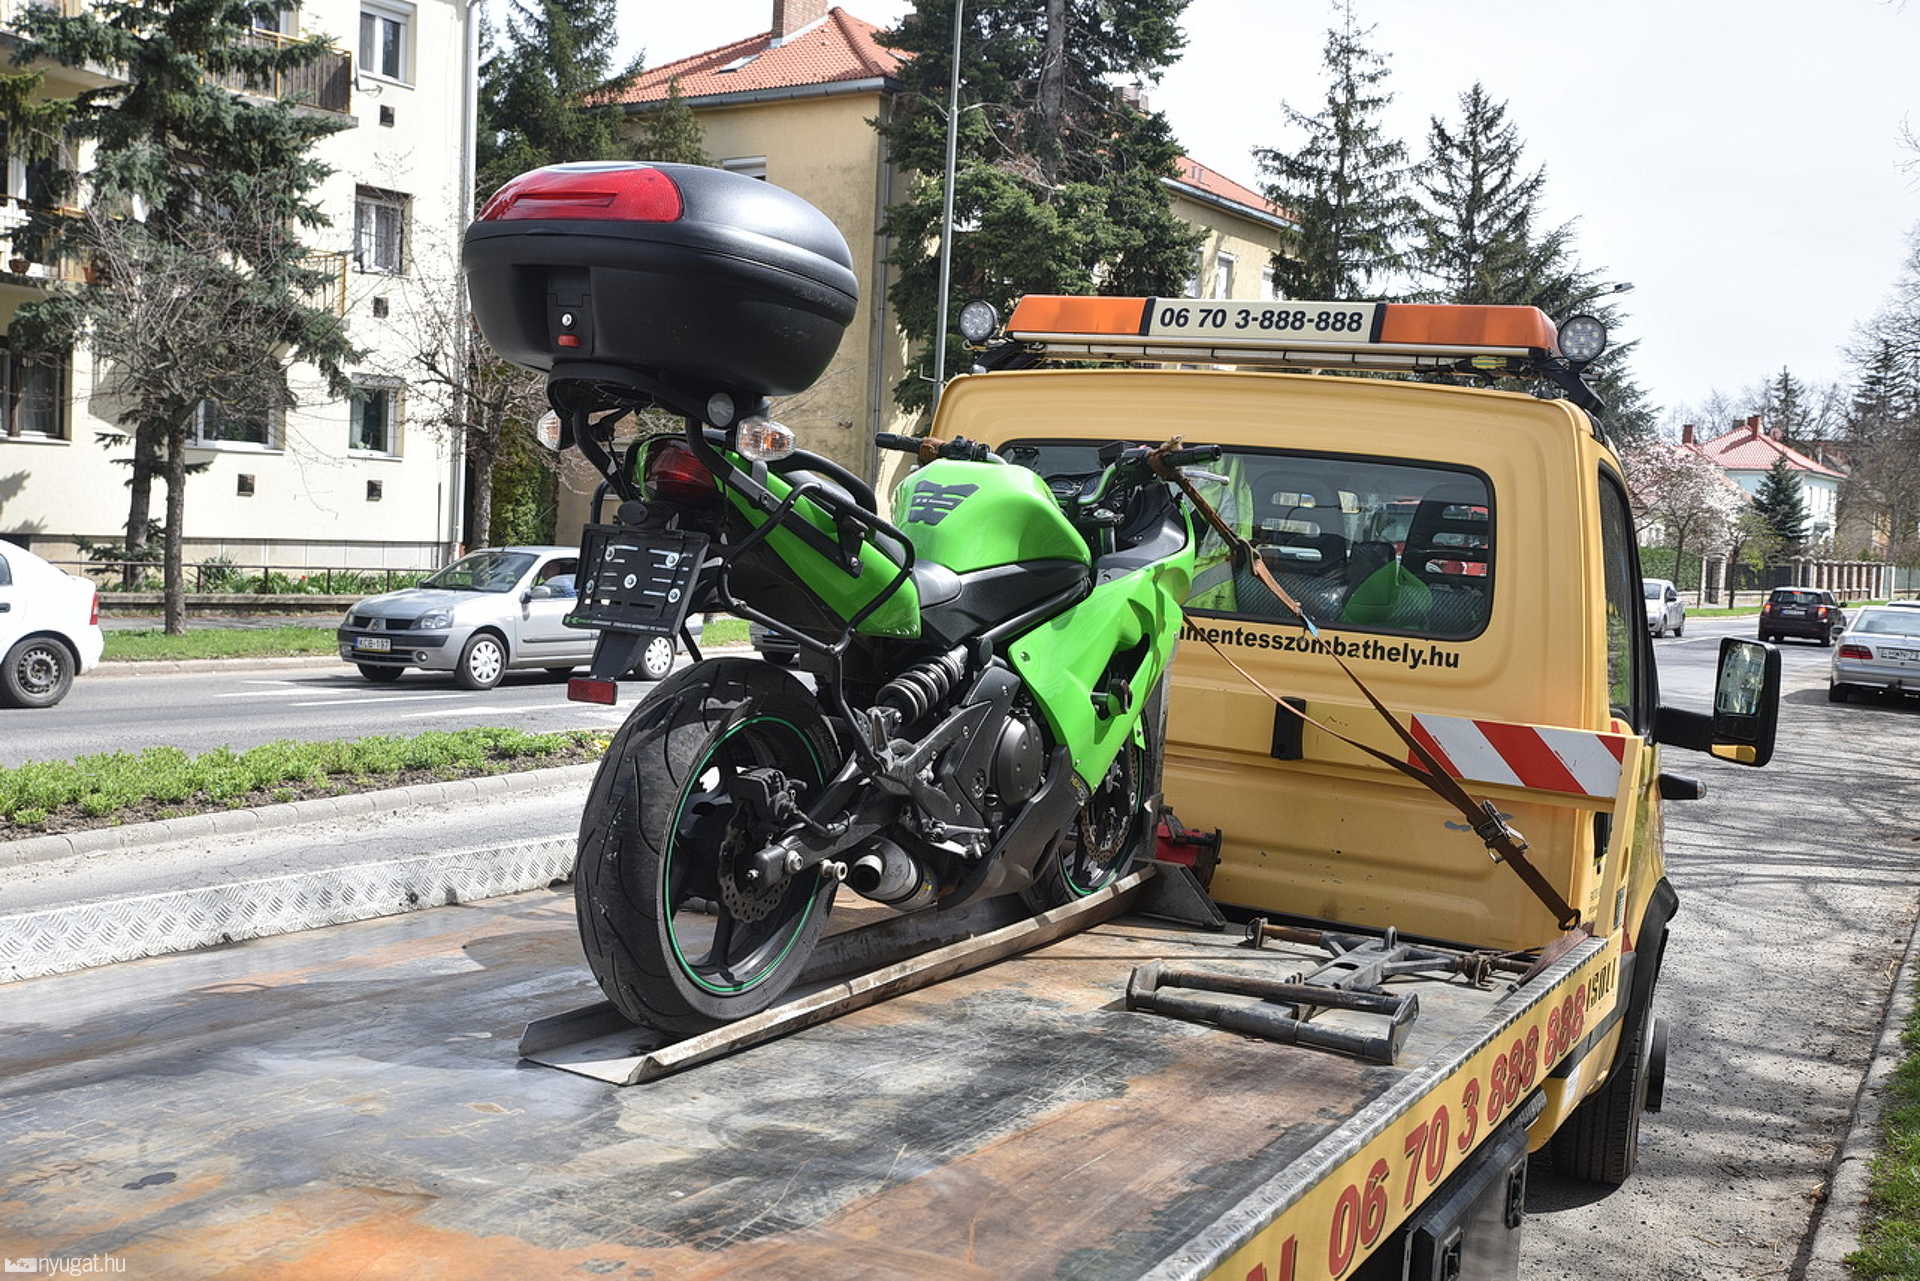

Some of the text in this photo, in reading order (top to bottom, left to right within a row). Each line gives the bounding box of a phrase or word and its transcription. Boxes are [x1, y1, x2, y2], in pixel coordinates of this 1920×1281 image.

[1159, 307, 1364, 333] 06 70 3-888-888
[1328, 1158, 1389, 1278] 06
[1403, 1104, 1450, 1212] 70
[1457, 1076, 1481, 1155] 3
[1487, 1024, 1539, 1125] 888
[1544, 983, 1586, 1068] 888
